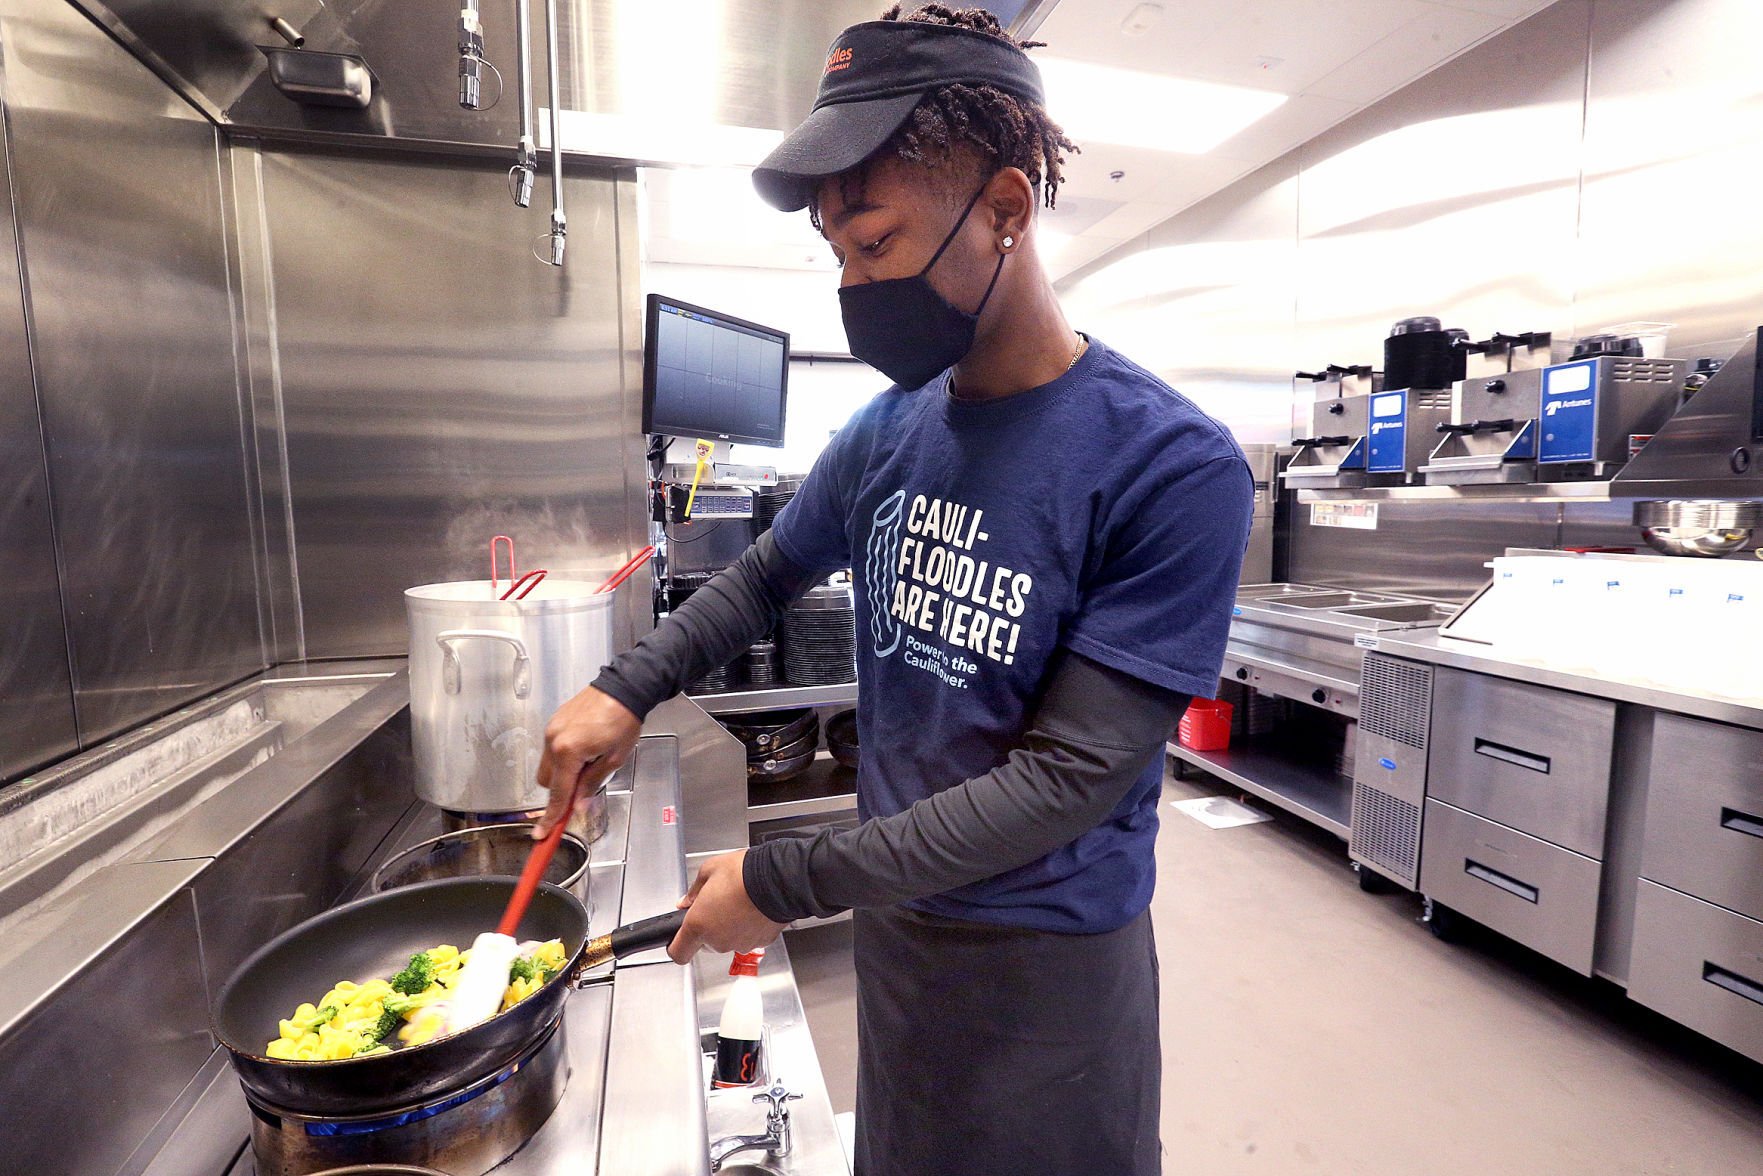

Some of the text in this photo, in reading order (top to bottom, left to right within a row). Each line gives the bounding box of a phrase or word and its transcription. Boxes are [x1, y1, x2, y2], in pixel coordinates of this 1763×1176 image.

[907, 494, 989, 551] CAULI-
[897, 536, 1033, 618] FLOODLES
[890, 580, 1021, 666] ARE HERE!
[906, 634, 942, 660] Power
[951, 656, 978, 674] the
